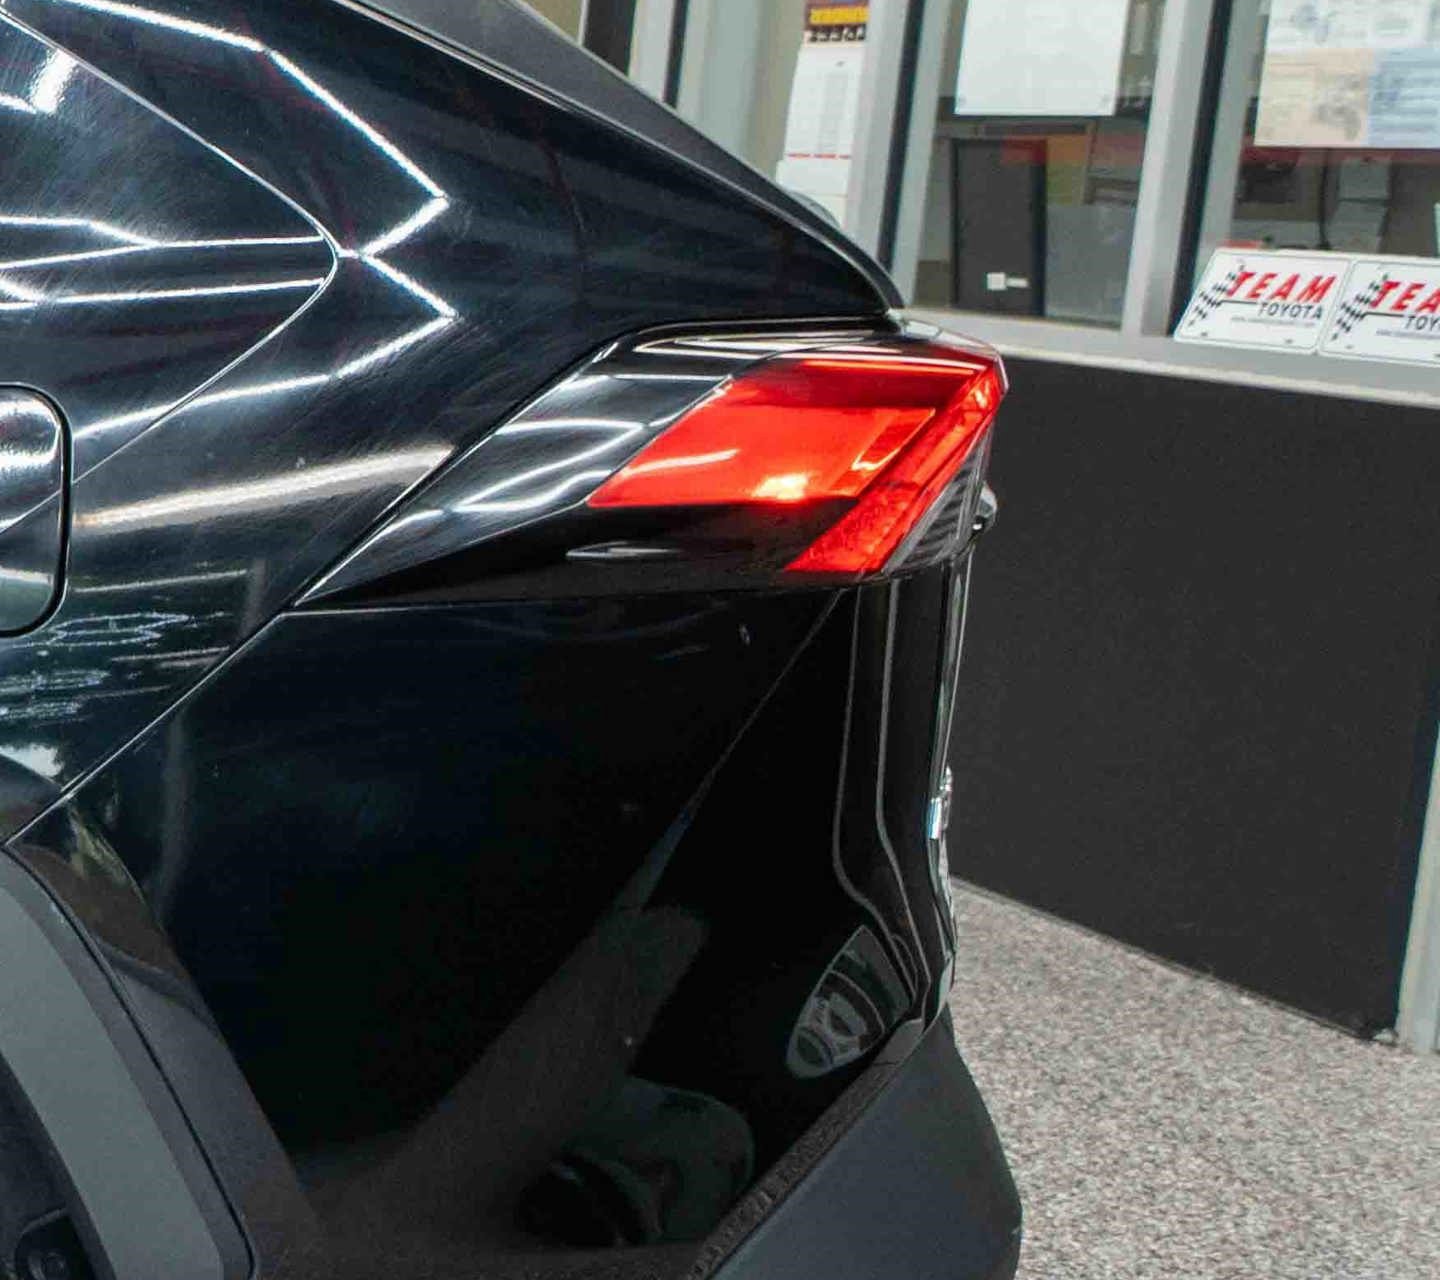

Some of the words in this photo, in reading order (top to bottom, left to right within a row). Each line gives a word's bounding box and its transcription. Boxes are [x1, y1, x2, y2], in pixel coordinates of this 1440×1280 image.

[1224, 271, 1338, 303] TEAM
[1257, 301, 1323, 319] TOYOTA
[1404, 315, 1440, 331] TOY
